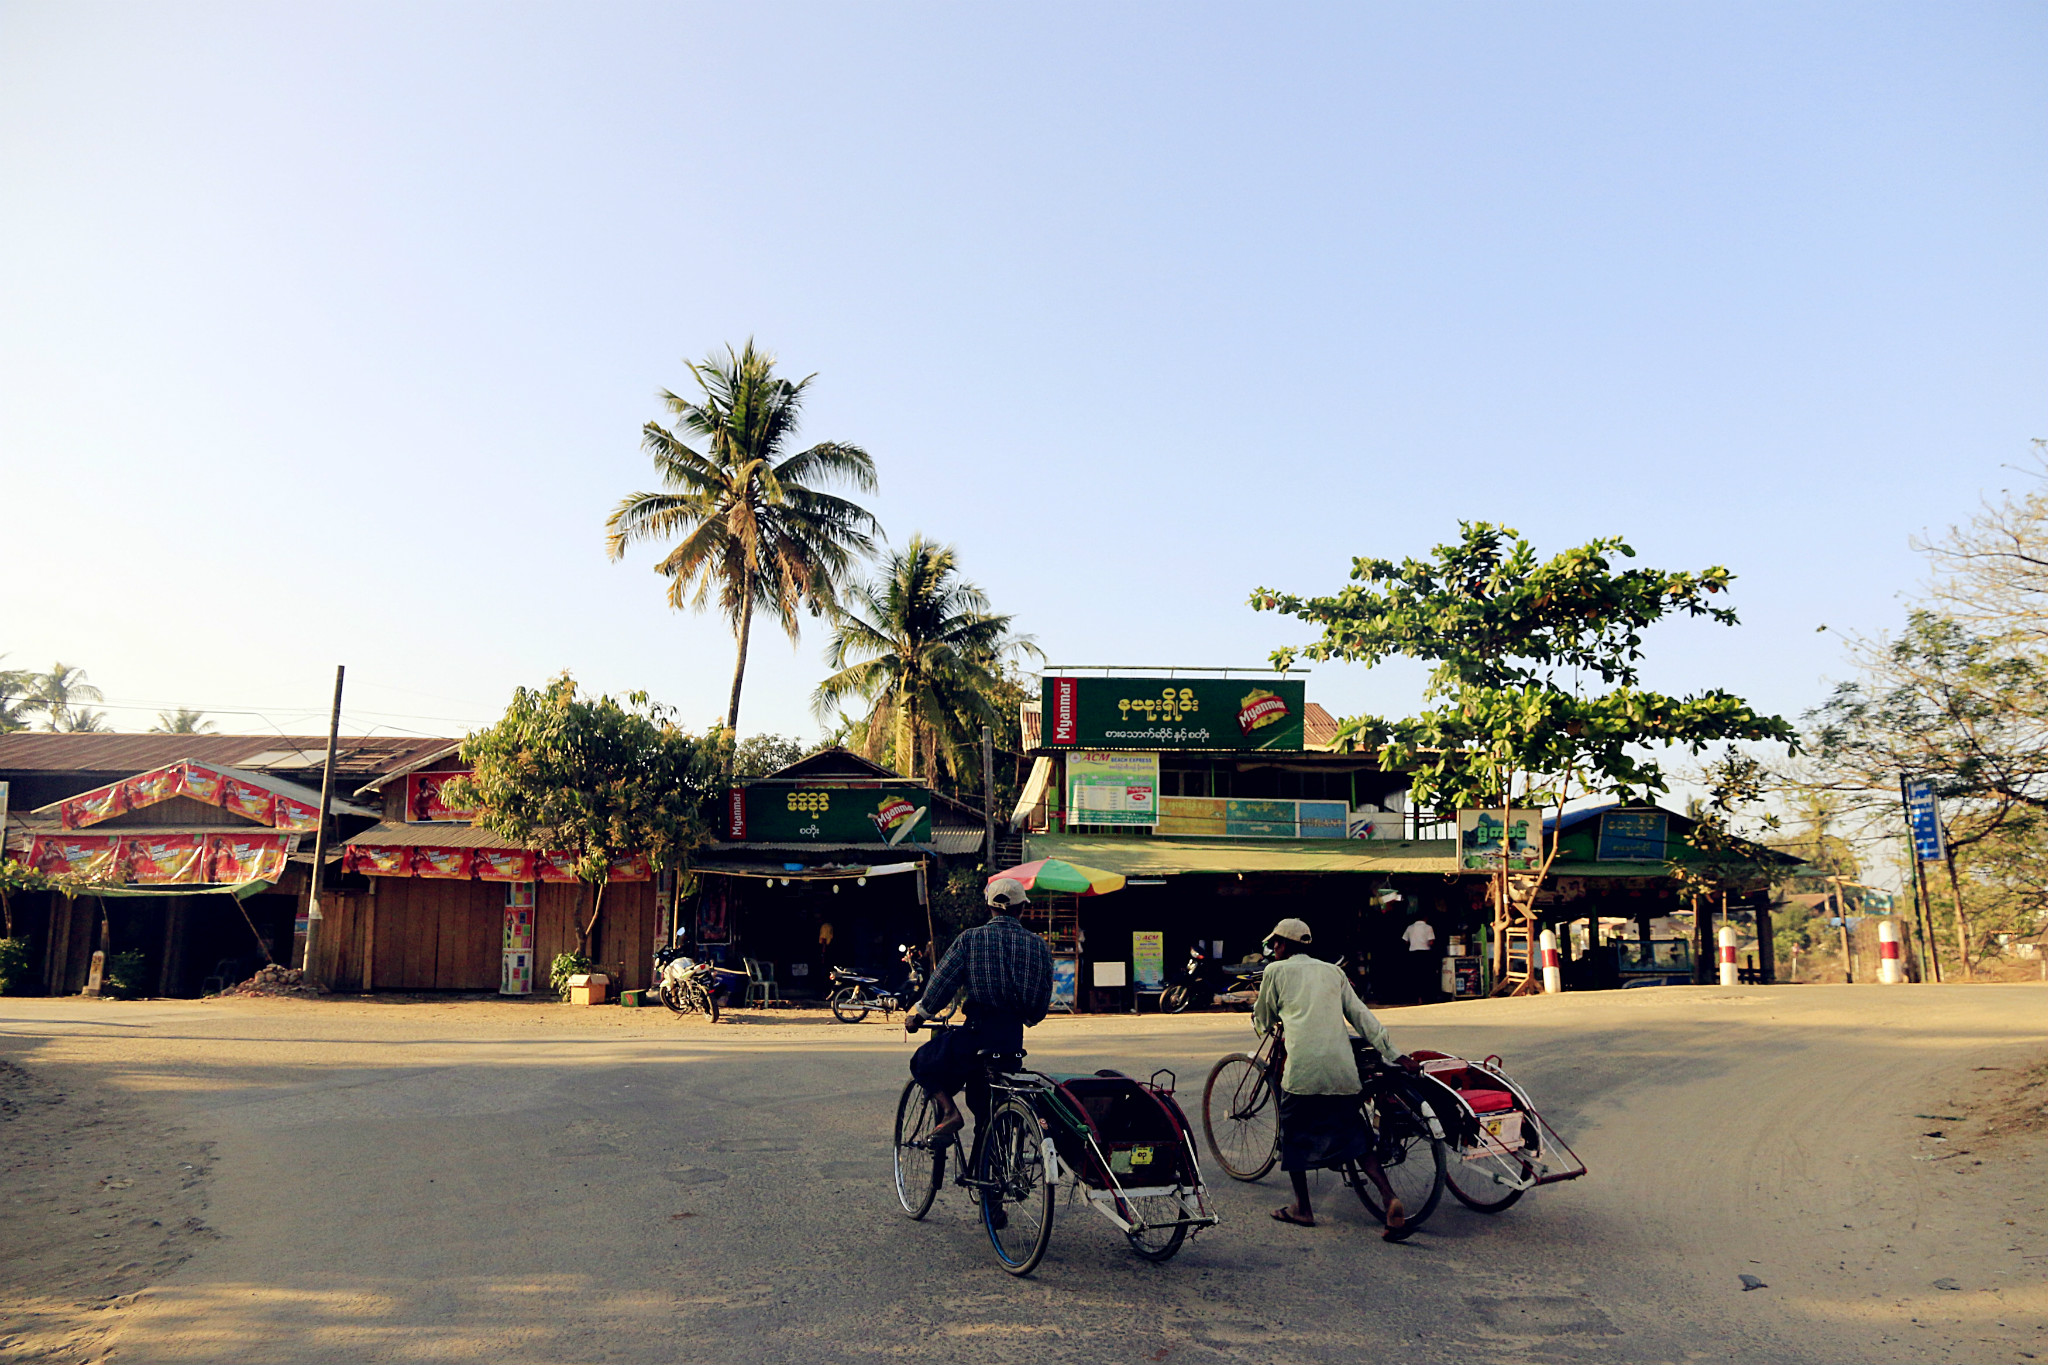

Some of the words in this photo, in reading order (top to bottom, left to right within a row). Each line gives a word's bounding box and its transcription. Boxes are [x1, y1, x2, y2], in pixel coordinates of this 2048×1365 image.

[1056, 681, 1072, 740] Myanmar
[1239, 700, 1286, 727] Myanmar
[1105, 727, 1173, 743] စားသောက်ဆိုင်
[1188, 728, 1210, 743] စတိုး
[1083, 753, 1111, 762] ACM
[732, 792, 742, 836] Myanmar
[877, 804, 915, 827] Myanmar
[799, 824, 820, 839] စတိုး
